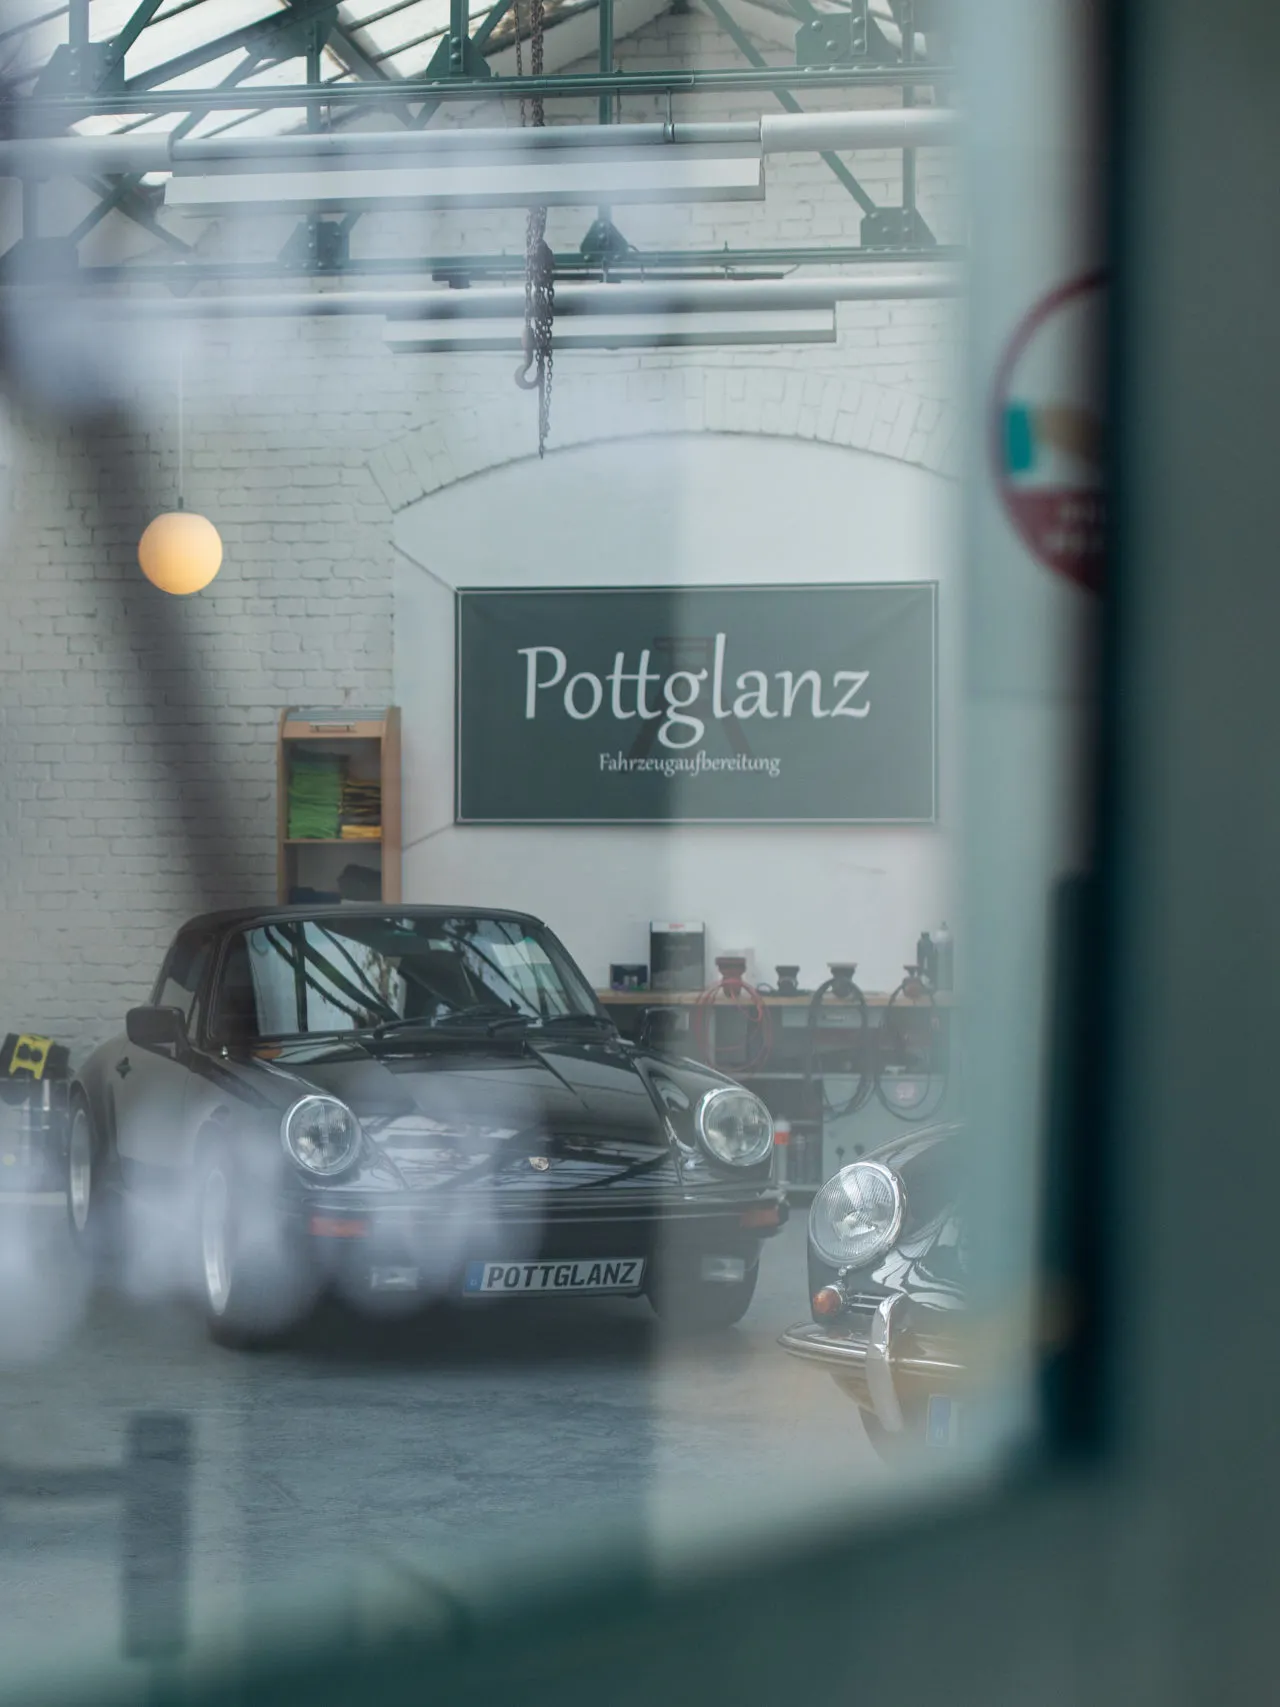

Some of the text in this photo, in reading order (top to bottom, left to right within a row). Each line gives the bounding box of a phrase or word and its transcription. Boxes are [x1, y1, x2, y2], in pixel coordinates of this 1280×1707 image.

[518, 632, 871, 749] Pottglanz
[599, 750, 781, 778] Fahrzeugaufbereitung
[486, 1261, 638, 1289] POTTGLANZ
